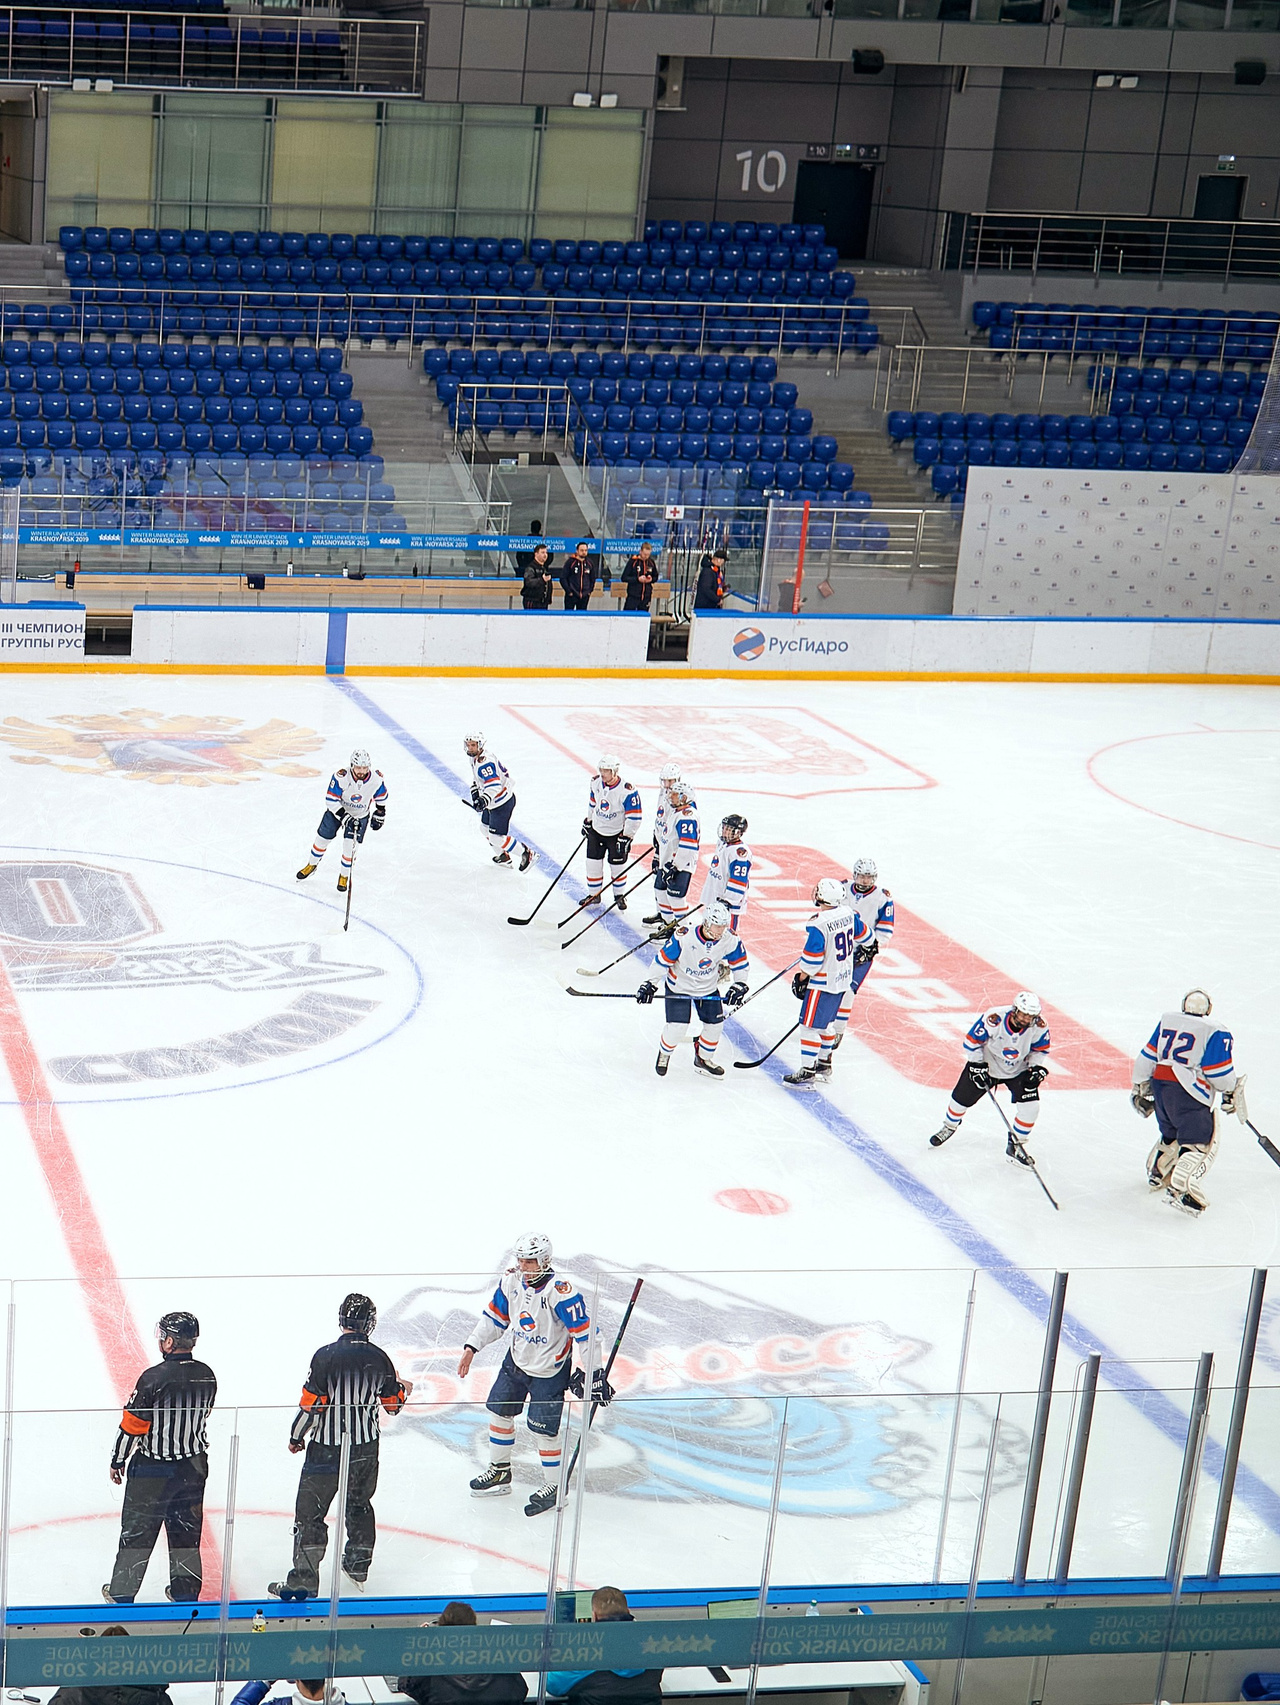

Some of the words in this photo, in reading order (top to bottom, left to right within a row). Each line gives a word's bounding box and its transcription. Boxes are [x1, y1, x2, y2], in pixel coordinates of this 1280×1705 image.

[816, 146, 826, 156] 10
[736, 150, 787, 193] 10
[1, 623, 13, 633] III
[0, 637, 54, 649] ГРУППЫ
[769, 637, 849, 655] РусГидро
[481, 766, 493, 777] 99
[681, 823, 694, 834] 24
[733, 865, 748, 876] 29
[835, 928, 853, 962] 96
[685, 967, 713, 976] РусГидр
[46, 991, 384, 1086] СОКОЛ
[1161, 1028, 1196, 1066] 72
[1223, 1038, 1234, 1052] 7
[1021, 1092, 1037, 1100] CCM
[566, 1301, 584, 1322] 77
